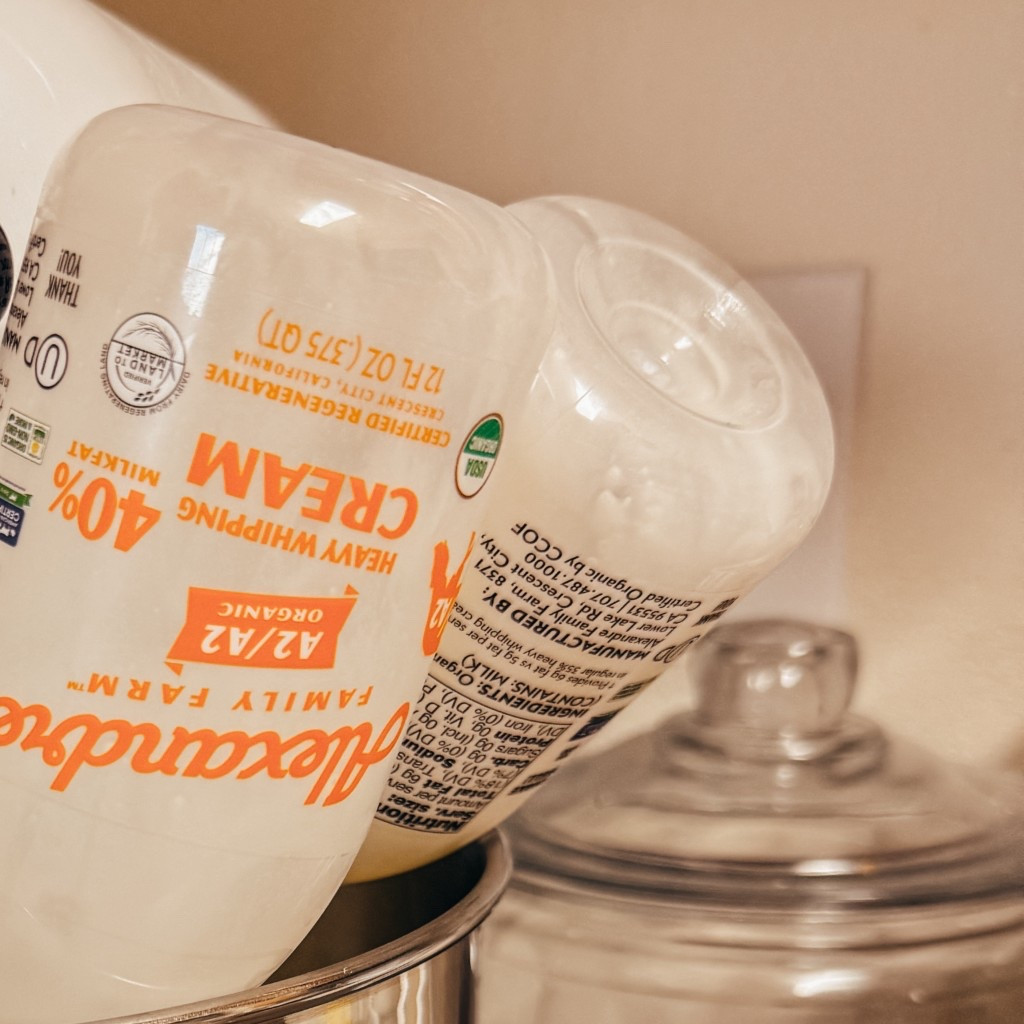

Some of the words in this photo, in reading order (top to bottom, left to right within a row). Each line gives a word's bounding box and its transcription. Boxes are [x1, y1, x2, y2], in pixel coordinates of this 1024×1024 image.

[56, 247, 82, 276] YOU!
[43, 273, 79, 308] THANK
[259, 311, 302, 354] QT)
[116, 343, 167, 366] MARKET
[305, 331, 361, 370] (.375
[115, 357, 126, 367] TO
[130, 360, 165, 379] LAND
[234, 352, 330, 387] CALIFORNIA
[361, 348, 396, 381] OZ
[402, 358, 423, 388] FL
[424, 366, 442, 394] 12
[208, 364, 362, 424] REGENERATIVE
[338, 381, 374, 402] CITY,
[379, 396, 438, 419] CRESCENT
[366, 413, 450, 447] CERTIFIED
[67, 440, 160, 489] MILKFAT
[464, 458, 487, 479] USDA
[186, 432, 419, 540] CREAM
[48, 464, 161, 552] 40%
[178, 496, 316, 558] WHIPPING
[481, 535, 509, 567] City,
[511, 524, 562, 560] CCOF
[320, 539, 397, 574] HEAVY
[566, 556, 585, 575] by
[475, 559, 506, 586] 8371
[525, 553, 620, 608] 707.487.1000
[511, 564, 573, 608] Crescent
[585, 569, 642, 600] Organic
[483, 587, 511, 613] BY:
[512, 583, 549, 615] Farm,
[641, 594, 701, 611] Certified
[217, 602, 323, 623] ORGANIC
[453, 602, 472, 620] crea
[576, 602, 602, 621] Rd,
[627, 606, 666, 620] 95531
[668, 613, 688, 624] CA
[550, 609, 598, 636] Family
[604, 614, 637, 631] Lake
[637, 624, 677, 636] Lower
[200, 623, 323, 659] A2/A2
[466, 631, 488, 644] per
[474, 618, 522, 651] whipping
[511, 610, 650, 659] MANUFACTURED
[599, 630, 664, 648] Alexandre
[487, 643, 502, 657] fat
[504, 649, 519, 664] 5g
[524, 648, 558, 669] heavy
[434, 653, 474, 685] Organ
[462, 654, 510, 685] MILK)
[520, 660, 532, 669] vs
[534, 666, 550, 678] fat
[550, 670, 566, 680] 6g
[556, 662, 580, 674] 35%
[581, 669, 616, 677] regular
[567, 676, 609, 689] Provides
[232, 685, 373, 712] FAMILY
[442, 689, 472, 714] DV),
[478, 682, 588, 717] INGREDIENTS:
[511, 680, 602, 710] (CONTAINS:
[425, 702, 440, 714] D
[474, 709, 504, 726] (0%
[418, 713, 438, 729] 0g
[444, 710, 463, 728] Vit.
[505, 720, 533, 734] Iron
[441, 726, 474, 745] (Incl.
[472, 721, 491, 739] 0g,
[494, 732, 554, 747] Protein
[438, 741, 467, 757] (0%
[475, 738, 493, 752] 0g
[495, 746, 542, 758] Sugars
[396, 752, 435, 776] Trans
[468, 750, 486, 763] 0g
[492, 757, 530, 769] Carb.
[402, 769, 420, 784] 6g
[424, 780, 452, 794] Fat
[388, 794, 430, 812] size:
[413, 791, 439, 801] per
[438, 797, 484, 809] Amount
[456, 788, 495, 799] Total
[378, 803, 465, 832] Nutrition
[437, 808, 476, 820] Serv.
